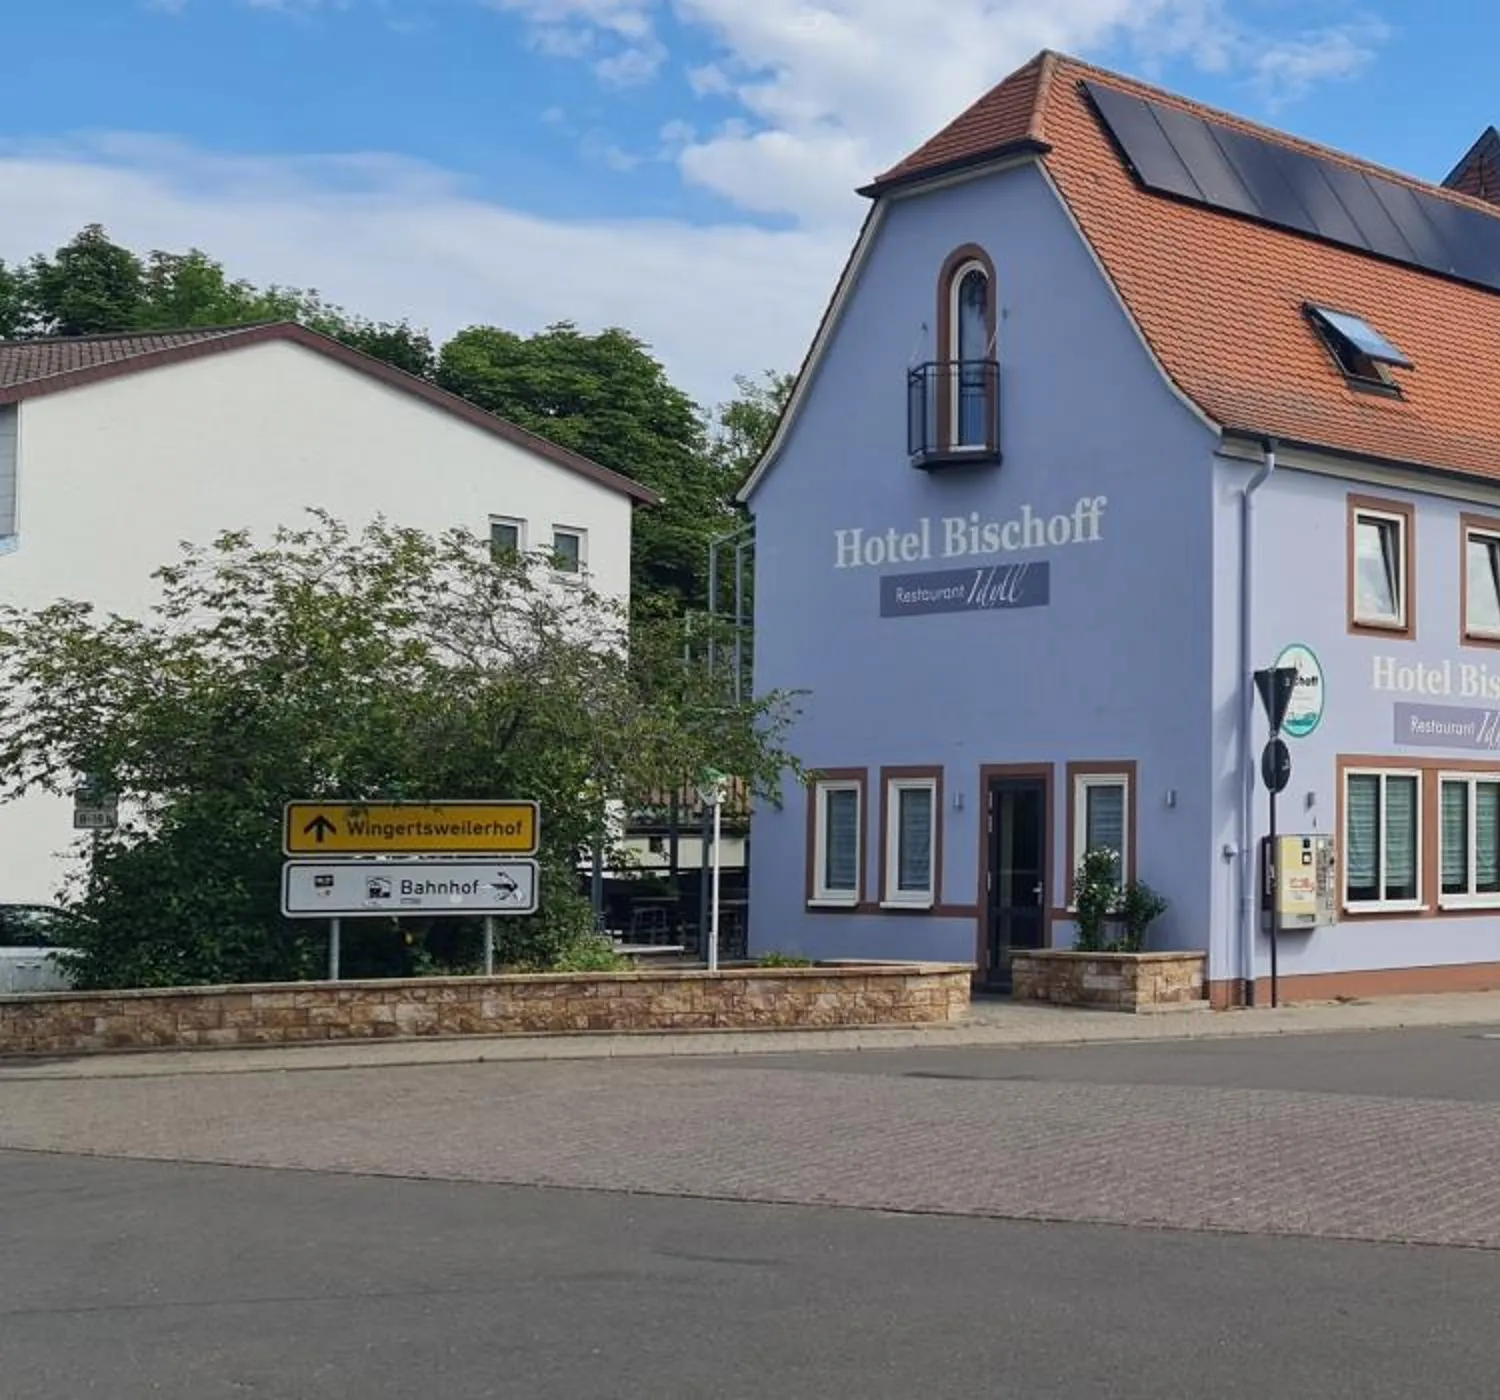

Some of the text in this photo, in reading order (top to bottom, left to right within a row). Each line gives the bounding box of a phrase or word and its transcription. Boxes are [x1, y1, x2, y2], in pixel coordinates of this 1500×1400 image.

[834, 495, 1108, 569] Hotel Bischoff
[895, 561, 1029, 609] Restaurant Idyll
[1372, 655, 1451, 694] Hotel
[1410, 714, 1475, 736] Restaurant
[347, 814, 523, 840] Wingertsweilerhof
[400, 878, 480, 896] Bahnhof
